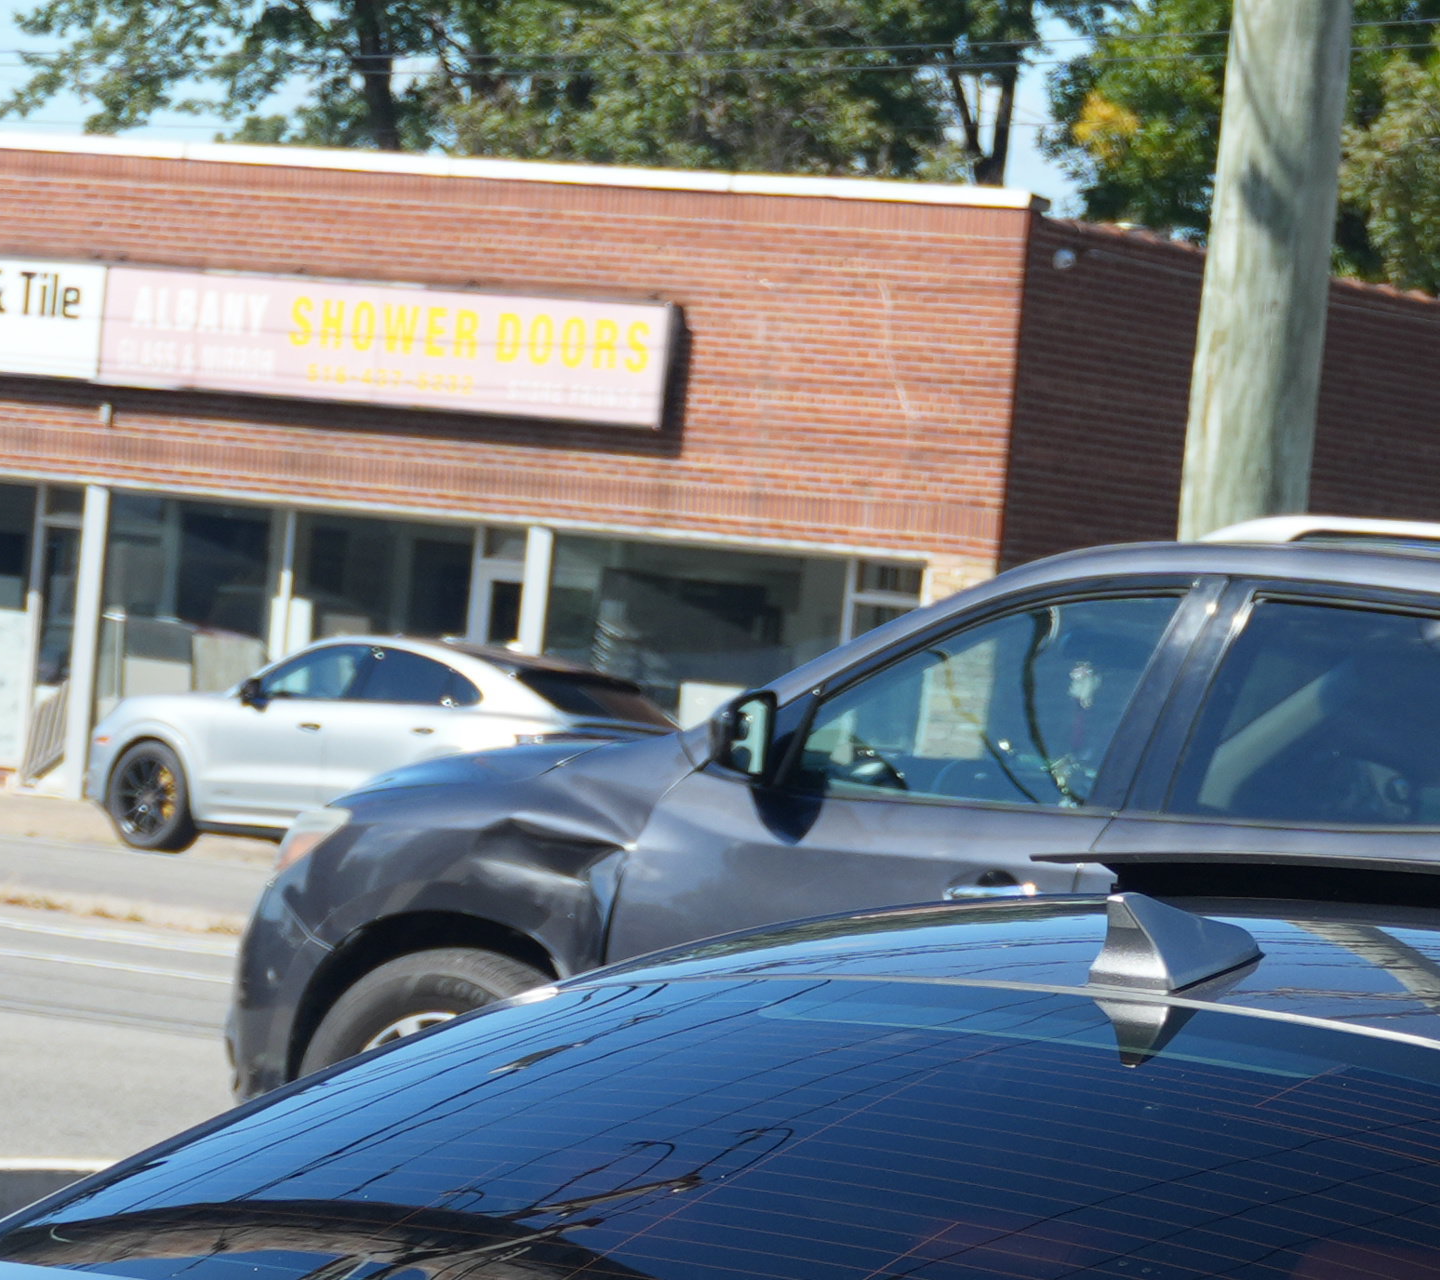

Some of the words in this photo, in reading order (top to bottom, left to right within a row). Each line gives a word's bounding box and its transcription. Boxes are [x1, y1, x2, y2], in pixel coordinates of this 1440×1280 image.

[21, 271, 81, 319] Tile
[130, 285, 271, 337] ALBANY
[288, 296, 479, 359] SHOWER
[495, 312, 651, 373] DOORS
